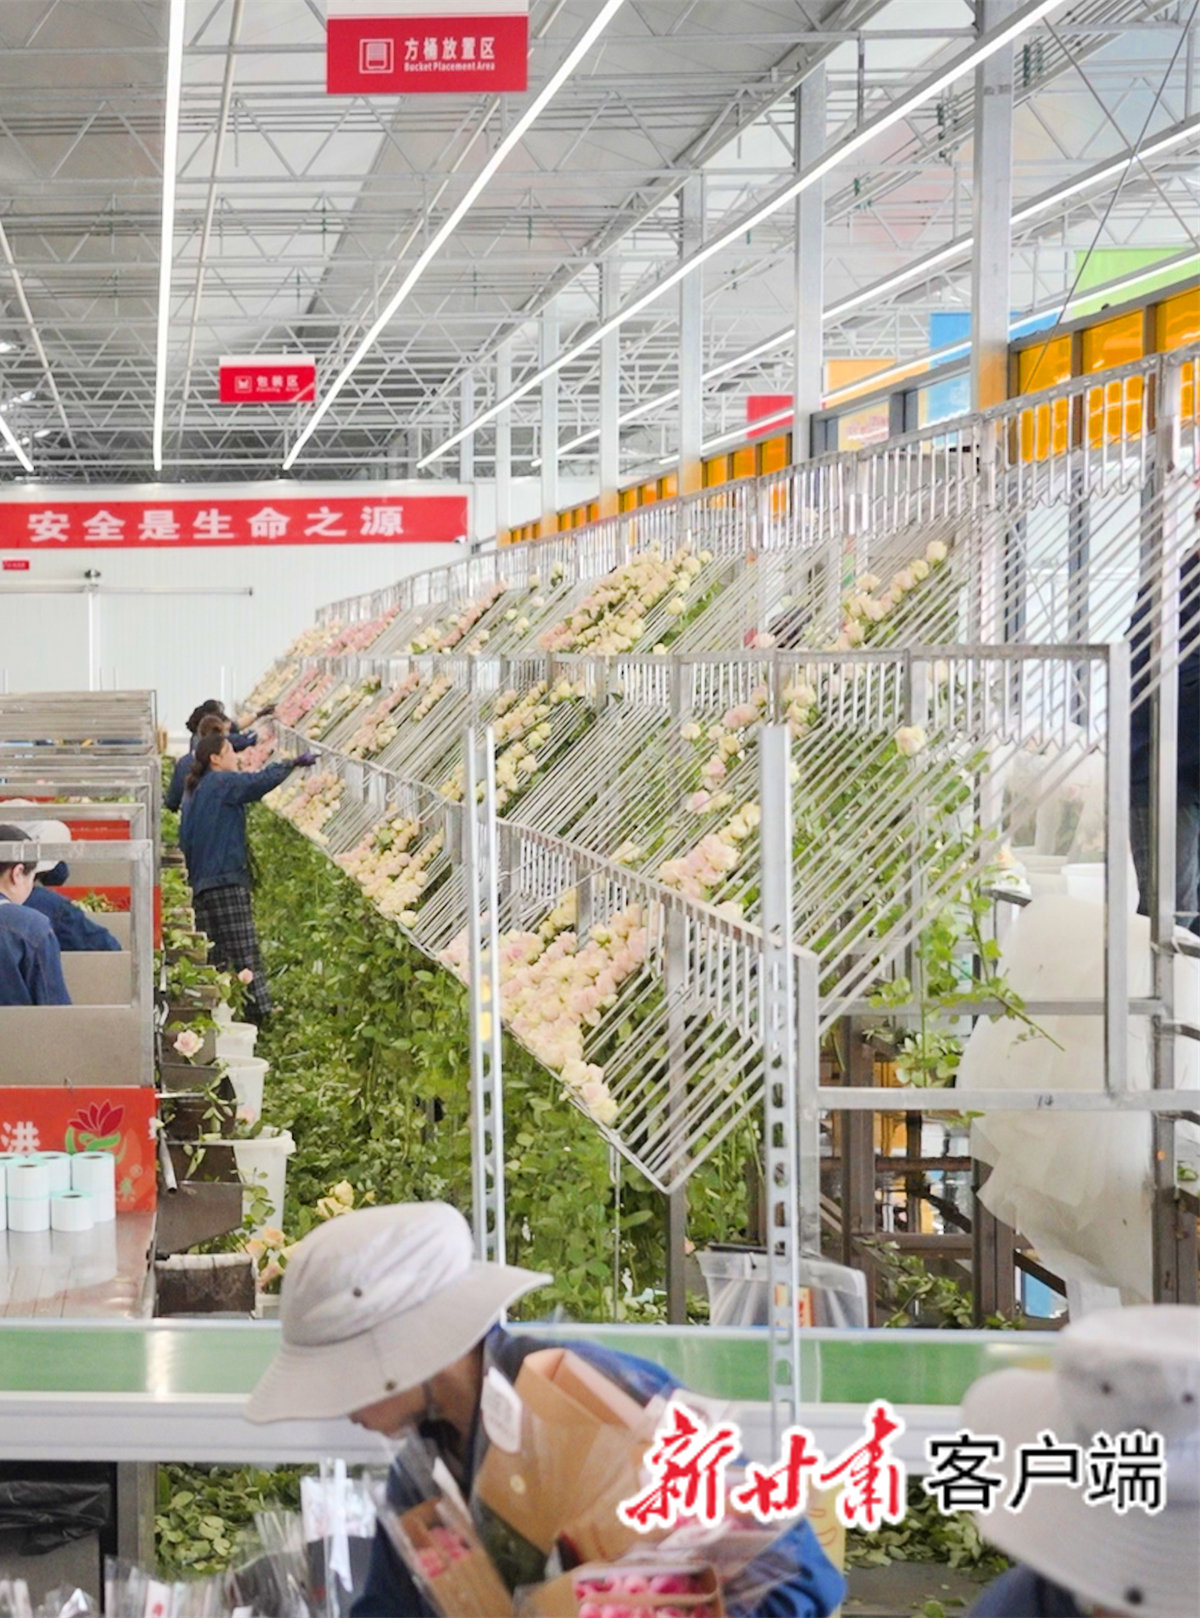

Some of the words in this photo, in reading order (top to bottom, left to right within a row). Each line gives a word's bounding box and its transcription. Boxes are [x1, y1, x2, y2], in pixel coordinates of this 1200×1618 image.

[404, 37, 495, 60] 方桶放置区
[404, 61, 432, 72] Bucket
[433, 61, 476, 72] Placement
[477, 61, 495, 71] Area
[27, 505, 405, 542] 安全是生命之源
